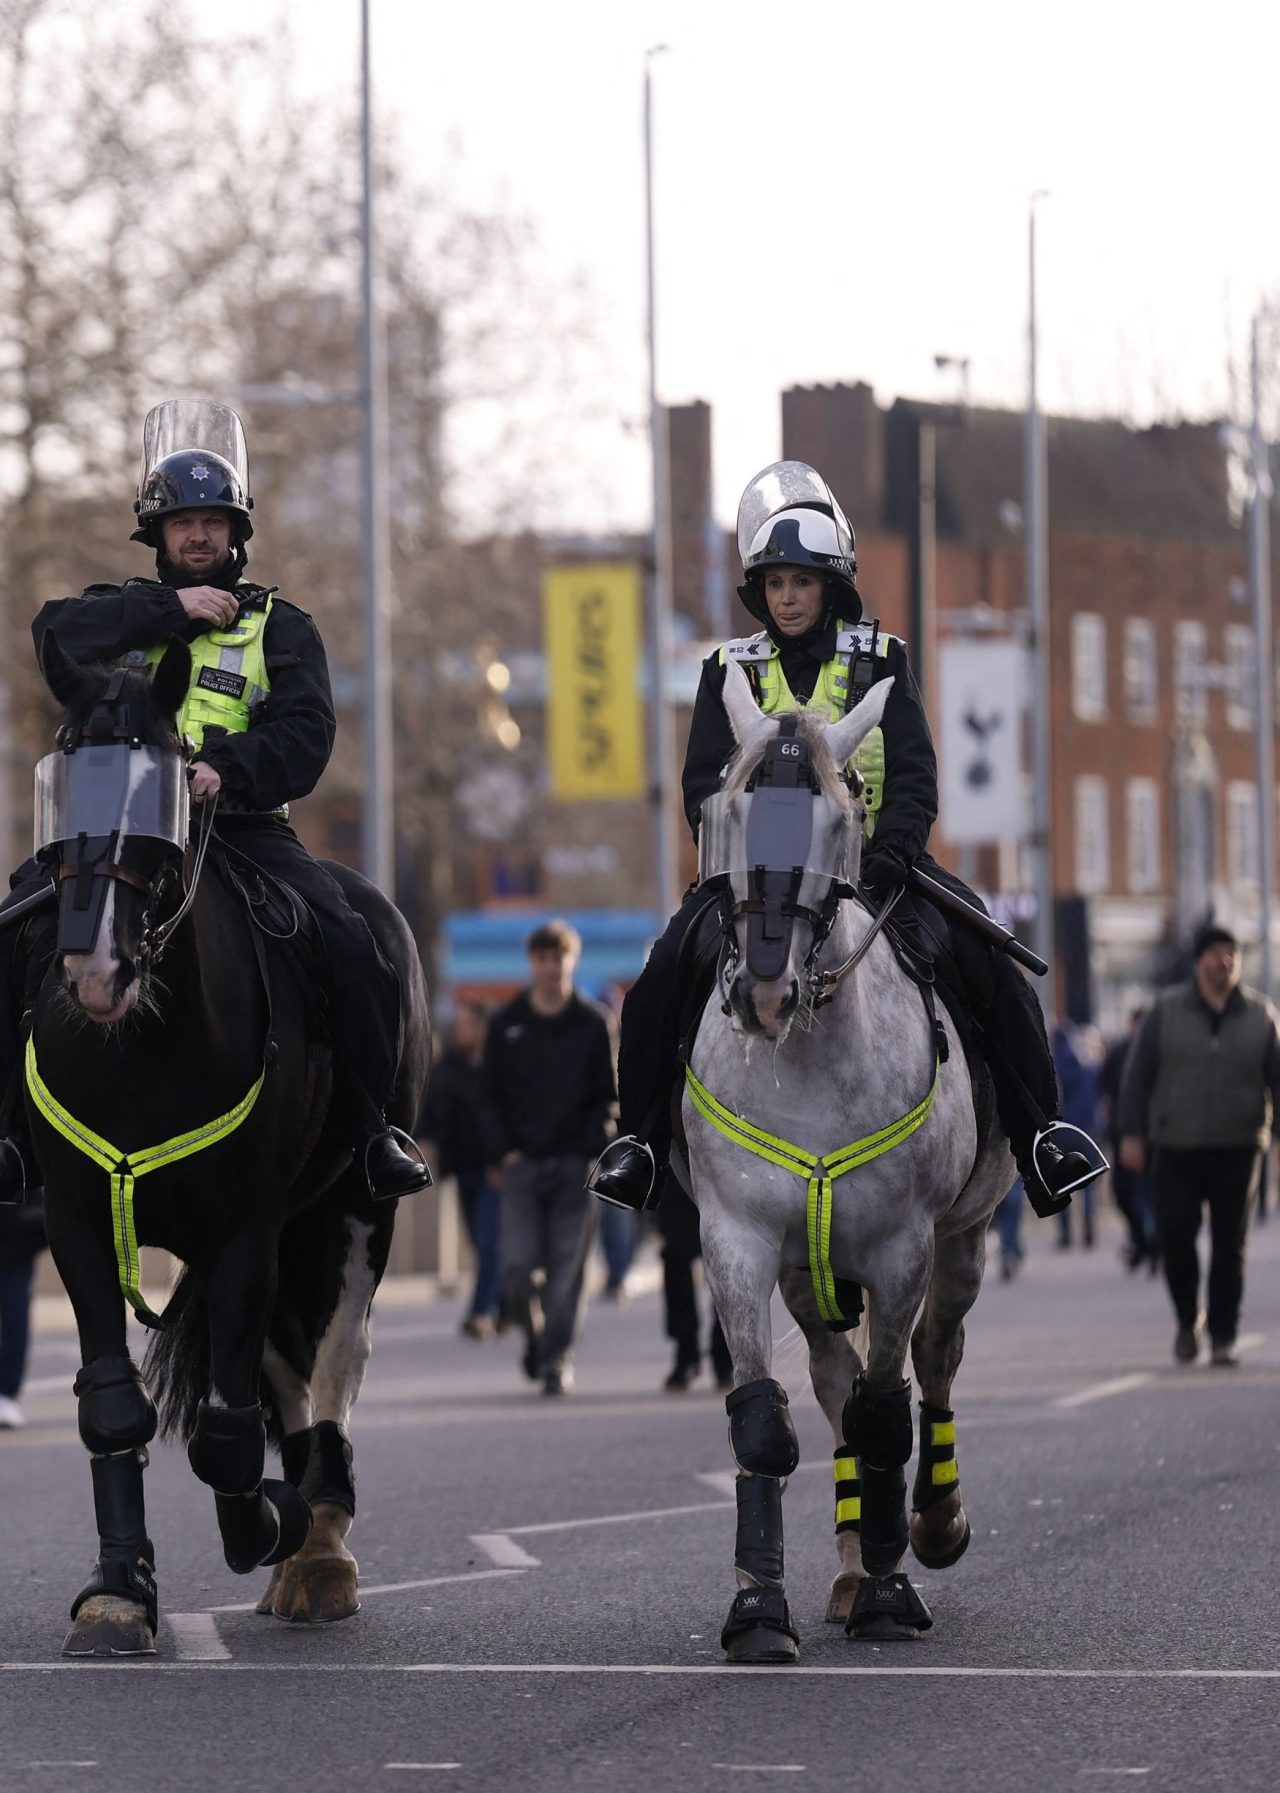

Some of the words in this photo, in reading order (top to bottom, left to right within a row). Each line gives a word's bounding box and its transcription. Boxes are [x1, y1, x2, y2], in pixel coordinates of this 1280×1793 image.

[200, 680, 219, 690] POLICE
[219, 686, 241, 696] OFFICER
[782, 744, 799, 756] 66
